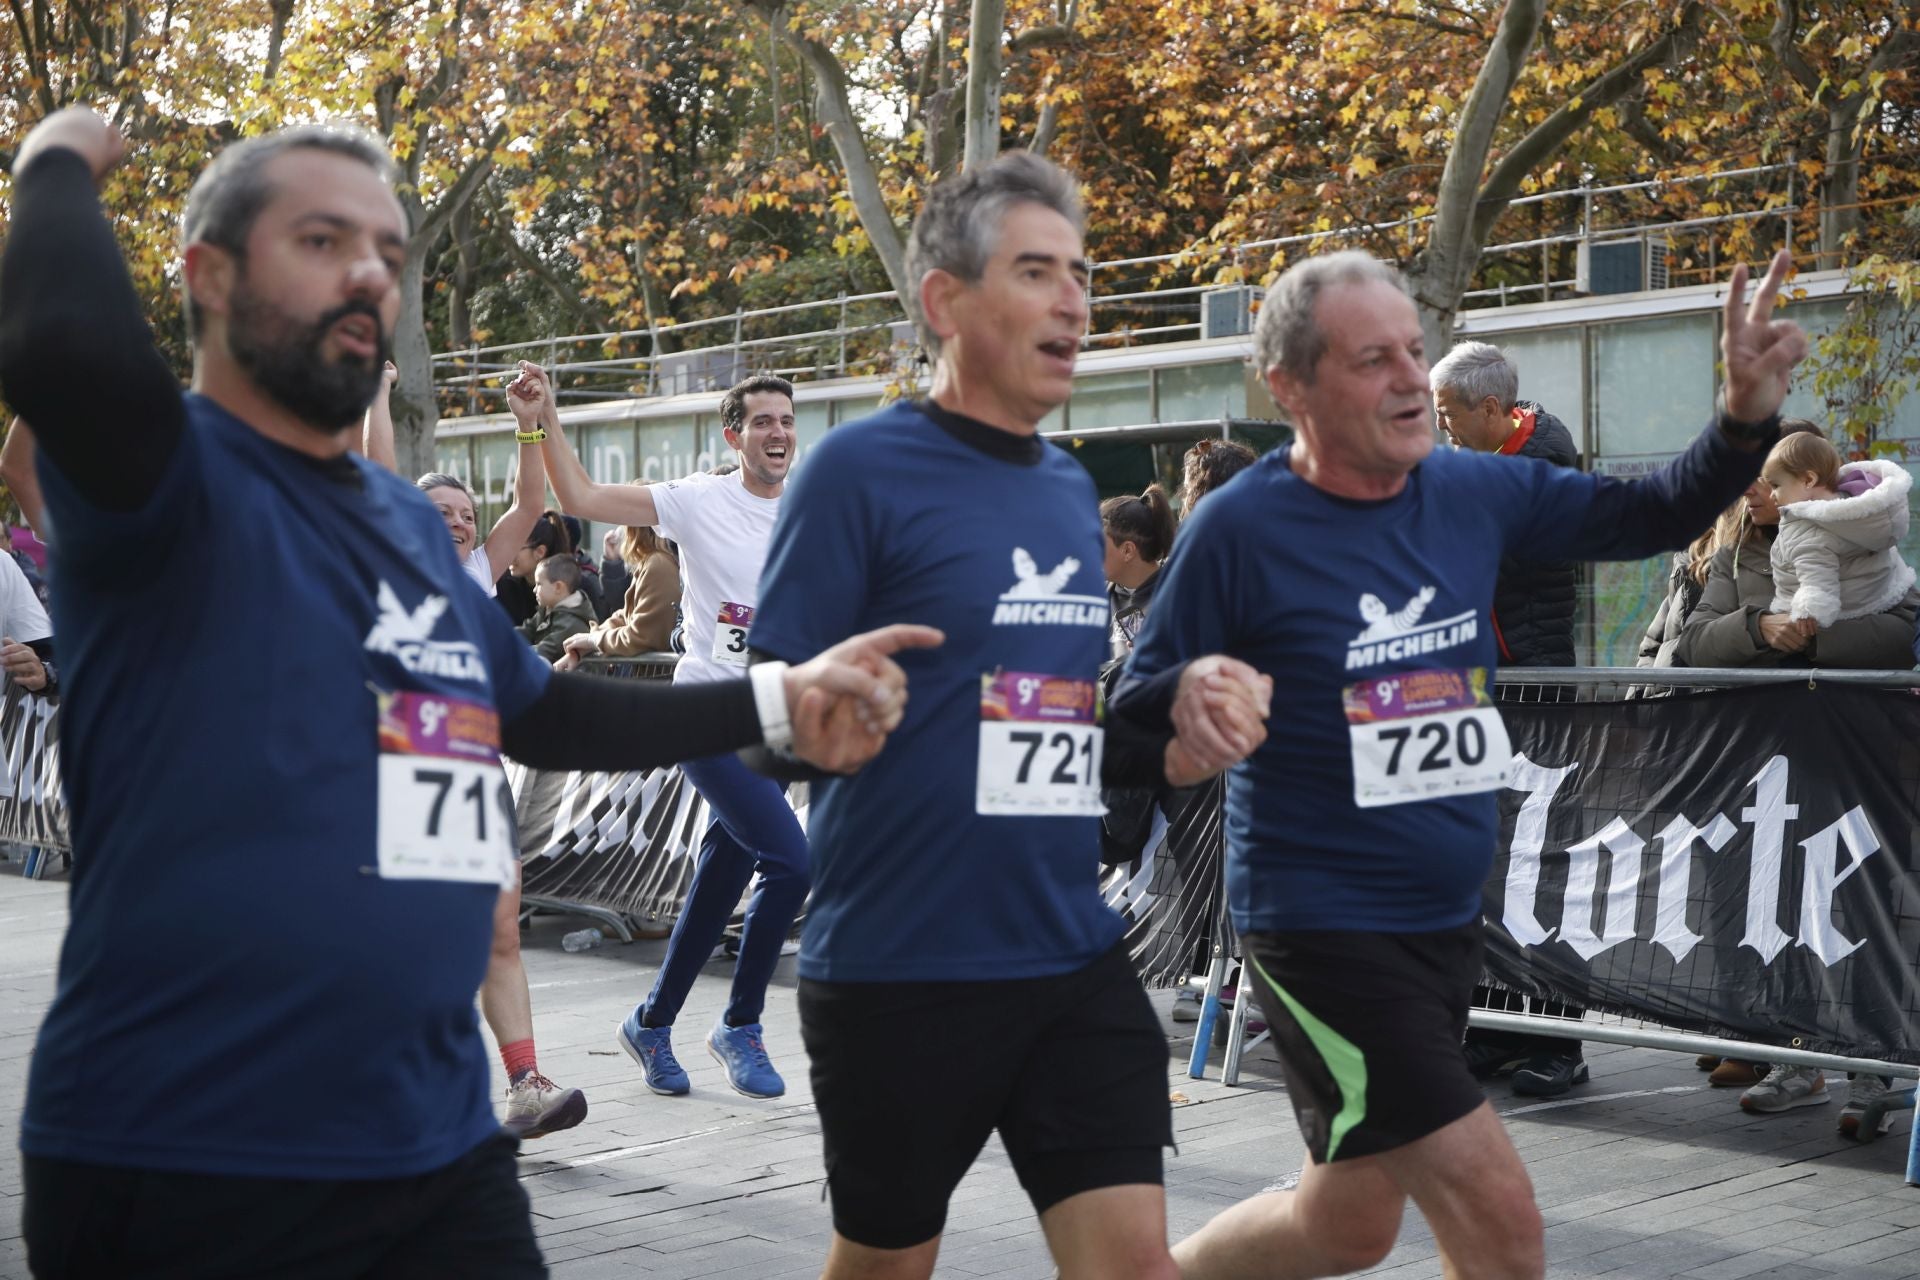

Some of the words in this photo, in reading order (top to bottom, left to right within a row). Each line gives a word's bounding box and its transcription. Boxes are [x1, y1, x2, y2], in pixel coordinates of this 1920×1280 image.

[437, 445, 627, 504] ALLAID
[992, 602, 1108, 627] MICHELIN
[726, 628, 752, 655] 3
[1345, 619, 1478, 671] MICHELIN
[1009, 731, 1094, 786] 721
[1377, 716, 1487, 776] 720
